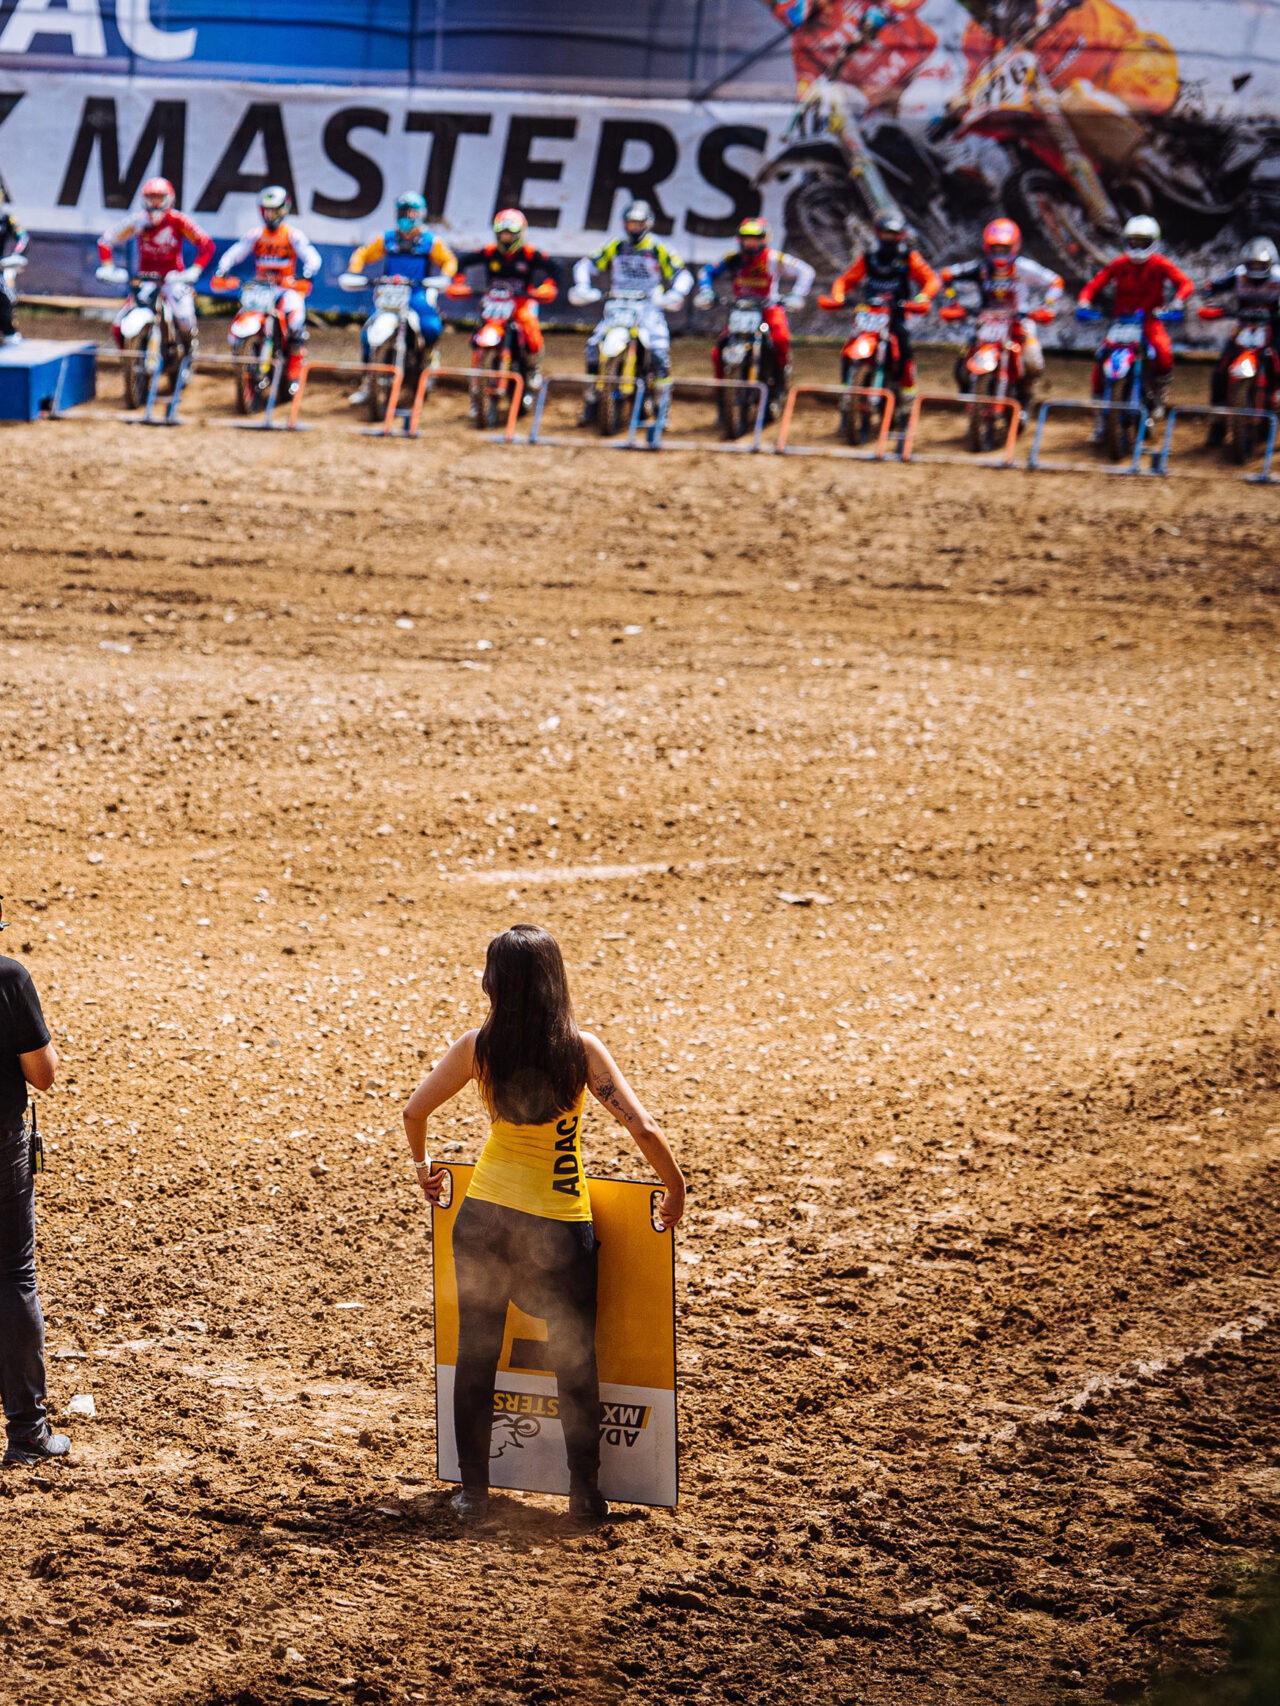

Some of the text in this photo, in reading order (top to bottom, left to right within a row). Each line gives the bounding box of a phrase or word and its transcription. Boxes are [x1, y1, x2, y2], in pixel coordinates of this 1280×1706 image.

[56, 96, 769, 237] MASTERS
[552, 1116, 580, 1197] ADAC
[493, 1392, 640, 1426] MX STERS
[600, 1427, 640, 1448] AD
